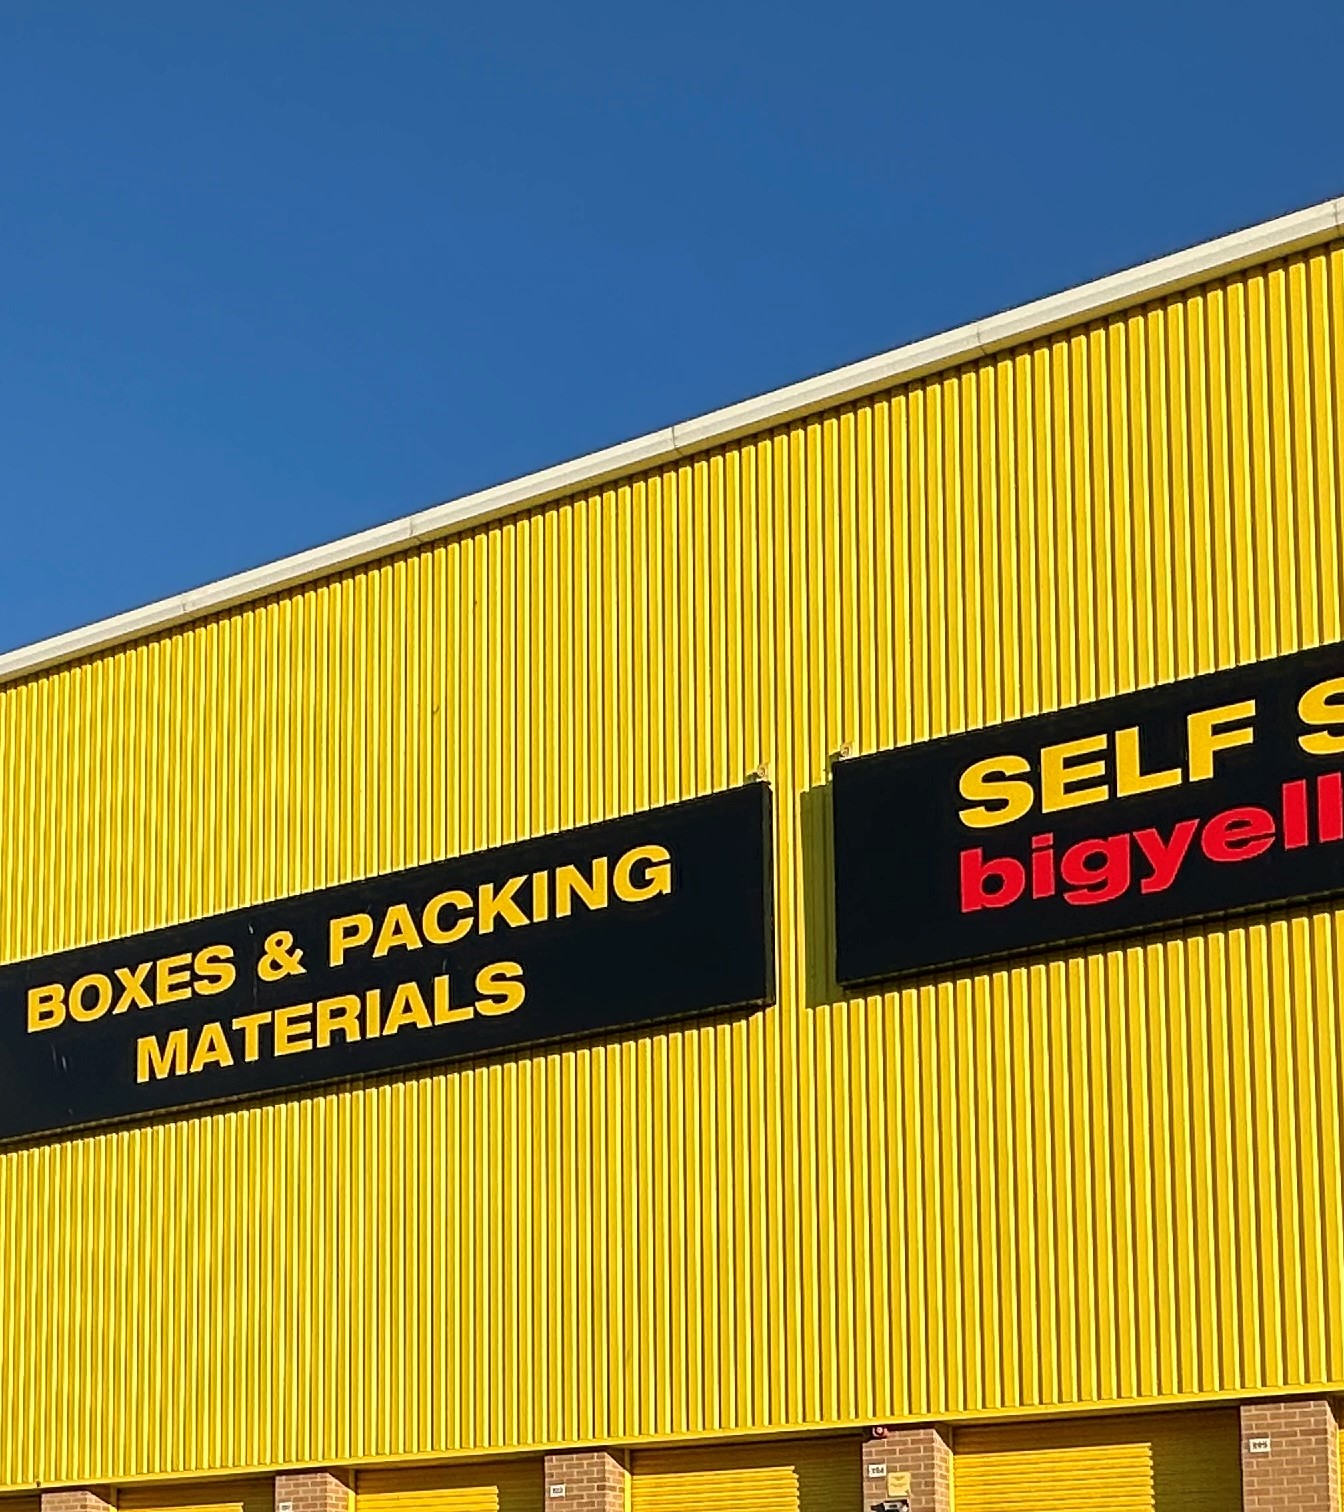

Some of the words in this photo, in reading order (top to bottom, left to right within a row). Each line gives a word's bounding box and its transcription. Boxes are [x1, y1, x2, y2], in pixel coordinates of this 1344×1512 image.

[958, 701, 1256, 829] SELF
[27, 944, 235, 1032] BOXES
[257, 931, 304, 981] &
[329, 844, 672, 966] PACKING
[136, 961, 526, 1083] MATERIALS
